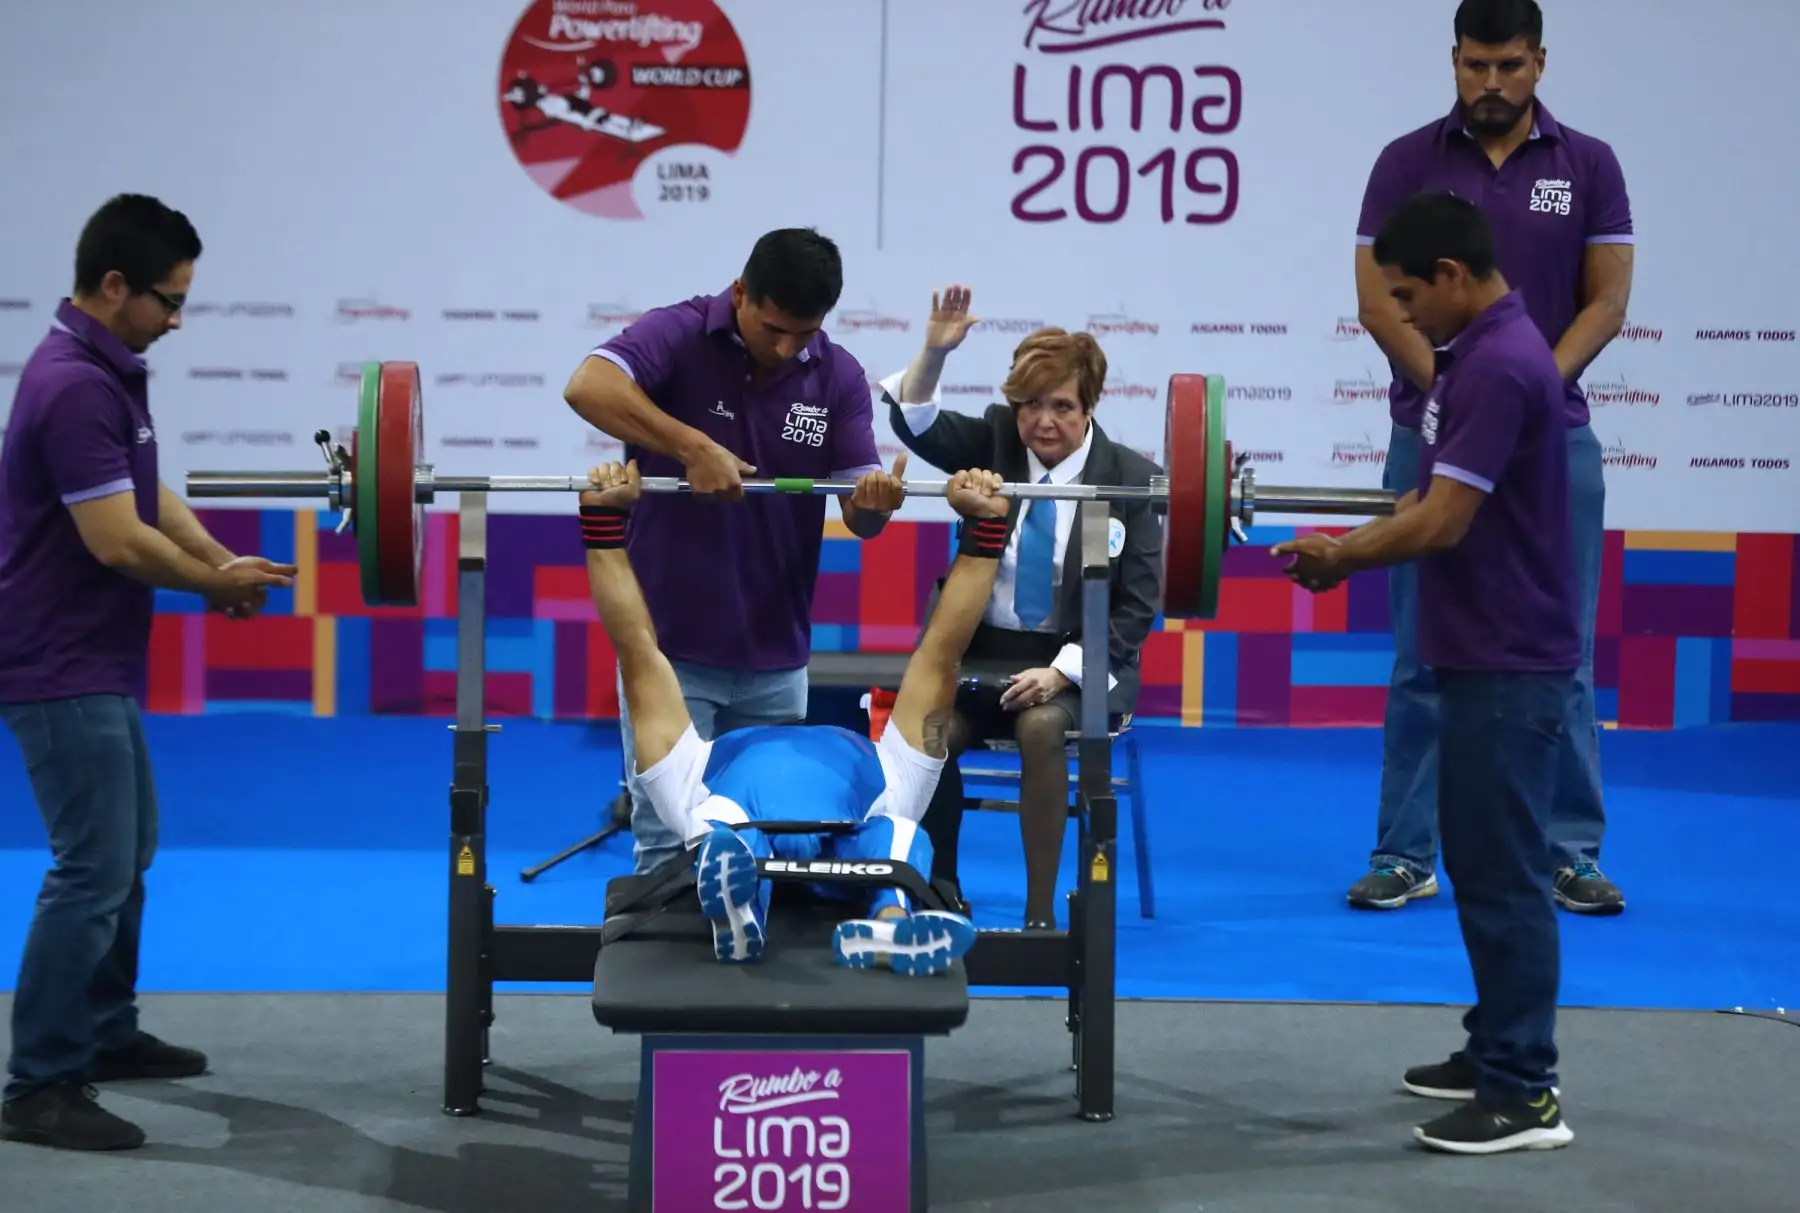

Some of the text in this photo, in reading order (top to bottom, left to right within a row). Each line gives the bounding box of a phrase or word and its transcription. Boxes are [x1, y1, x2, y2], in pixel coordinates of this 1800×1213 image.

[632, 67, 743, 87] WORLD CUP
[657, 163, 710, 181] LIMA
[658, 184, 710, 202] 2019
[1011, 145, 1240, 225] 2019
[1529, 199, 1570, 216] 2019
[1250, 324, 1288, 335] TODOS
[1620, 326, 1663, 342] rlifting
[1695, 329, 1796, 341] JUGAMOS TODOS
[1333, 387, 1390, 402] Powerlift
[1585, 388, 1660, 407] Powerlifting
[781, 426, 824, 447] 2019
[1332, 450, 1387, 465] Powerlift
[1602, 453, 1658, 470] werlifting
[1690, 457, 1790, 470] JUGAMOS TODOS
[764, 861, 894, 875] ELEIKO
[718, 1066, 843, 1112] Rumbo a
[713, 1163, 850, 1210] 2019
